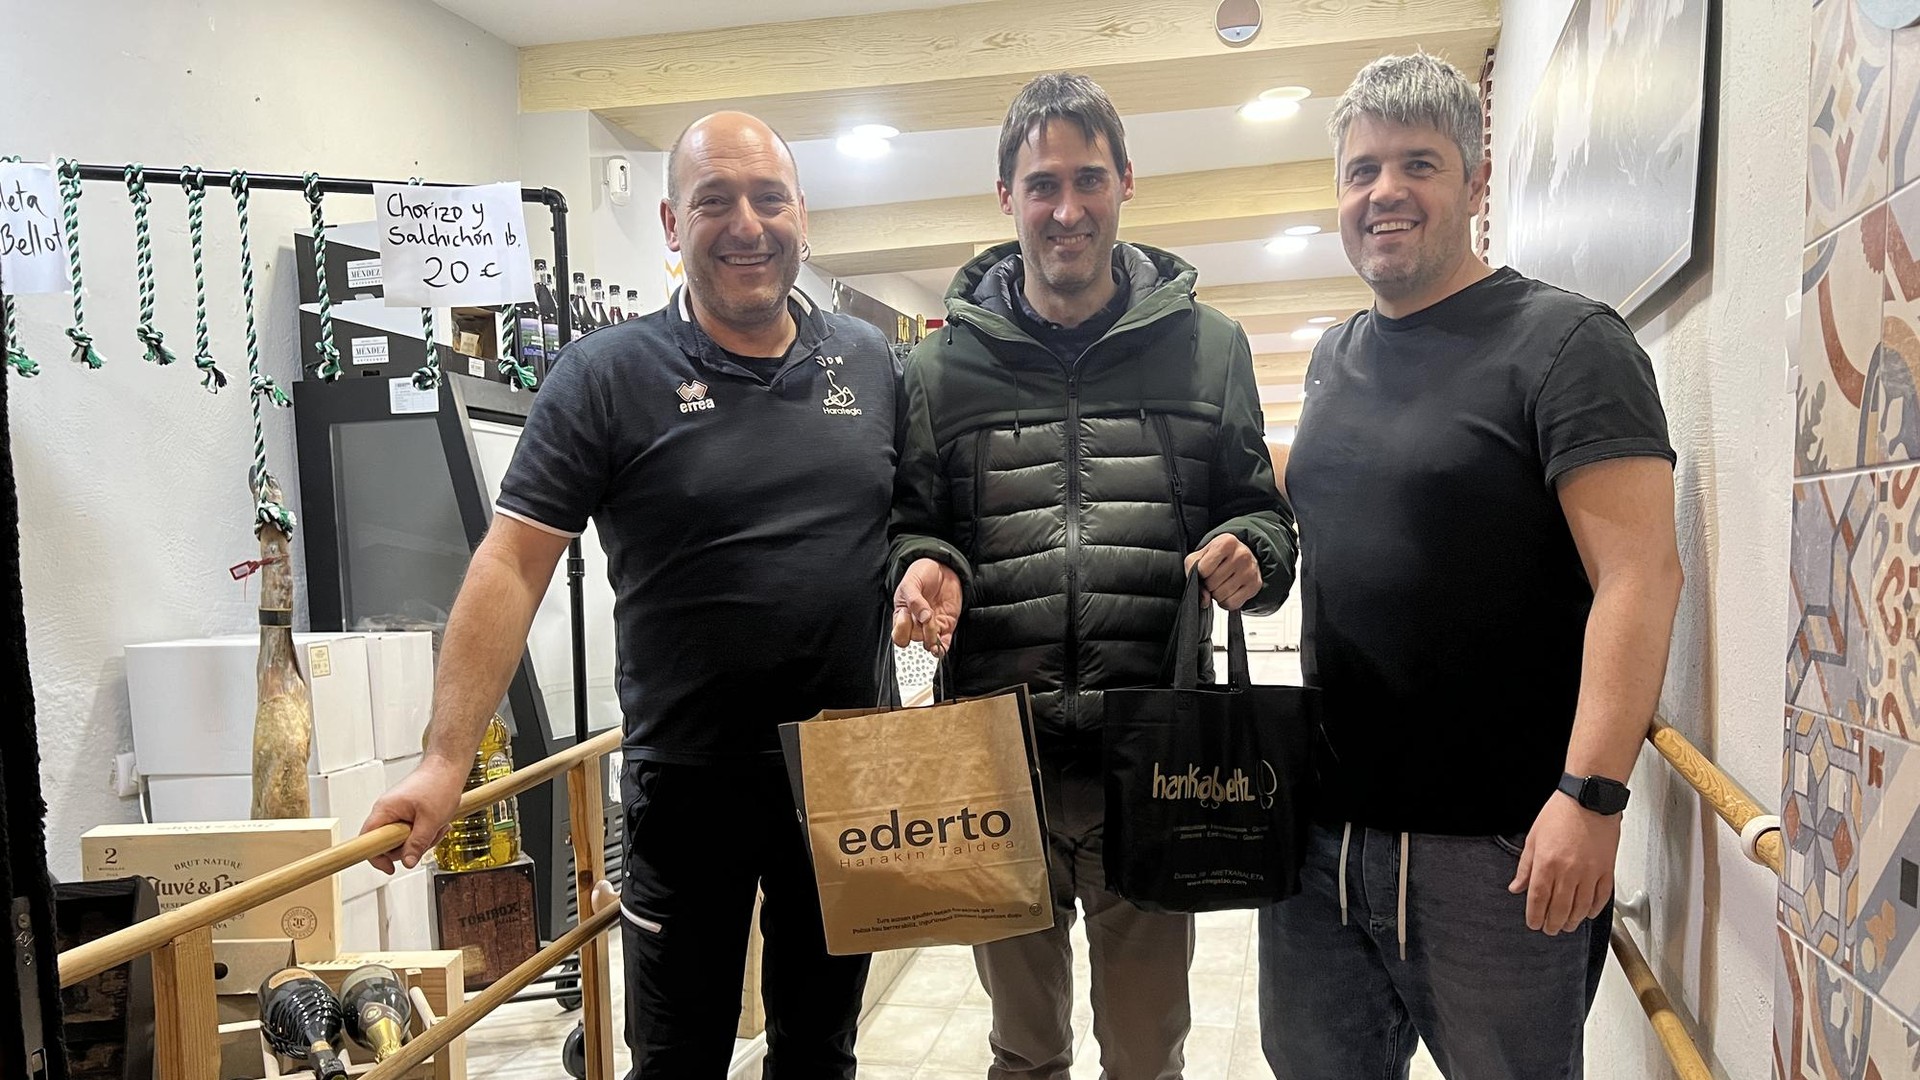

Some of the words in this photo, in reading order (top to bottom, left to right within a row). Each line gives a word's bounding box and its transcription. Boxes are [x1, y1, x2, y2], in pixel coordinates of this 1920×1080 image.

[387, 193, 463, 223] Chorizo
[472, 203, 485, 230] y
[388, 223, 493, 247] Salchichón
[351, 267, 381, 279] MÉNDEZ
[423, 257, 470, 288] 20
[480, 262, 503, 278] €
[355, 345, 386, 356] MÉNDEZ
[838, 807, 1012, 855] ederto
[104, 848, 118, 864] 2
[173, 859, 201, 871] BRUT
[203, 857, 243, 870] NATURE
[839, 851, 926, 869] Harakin
[939, 840, 1015, 856] Taldea
